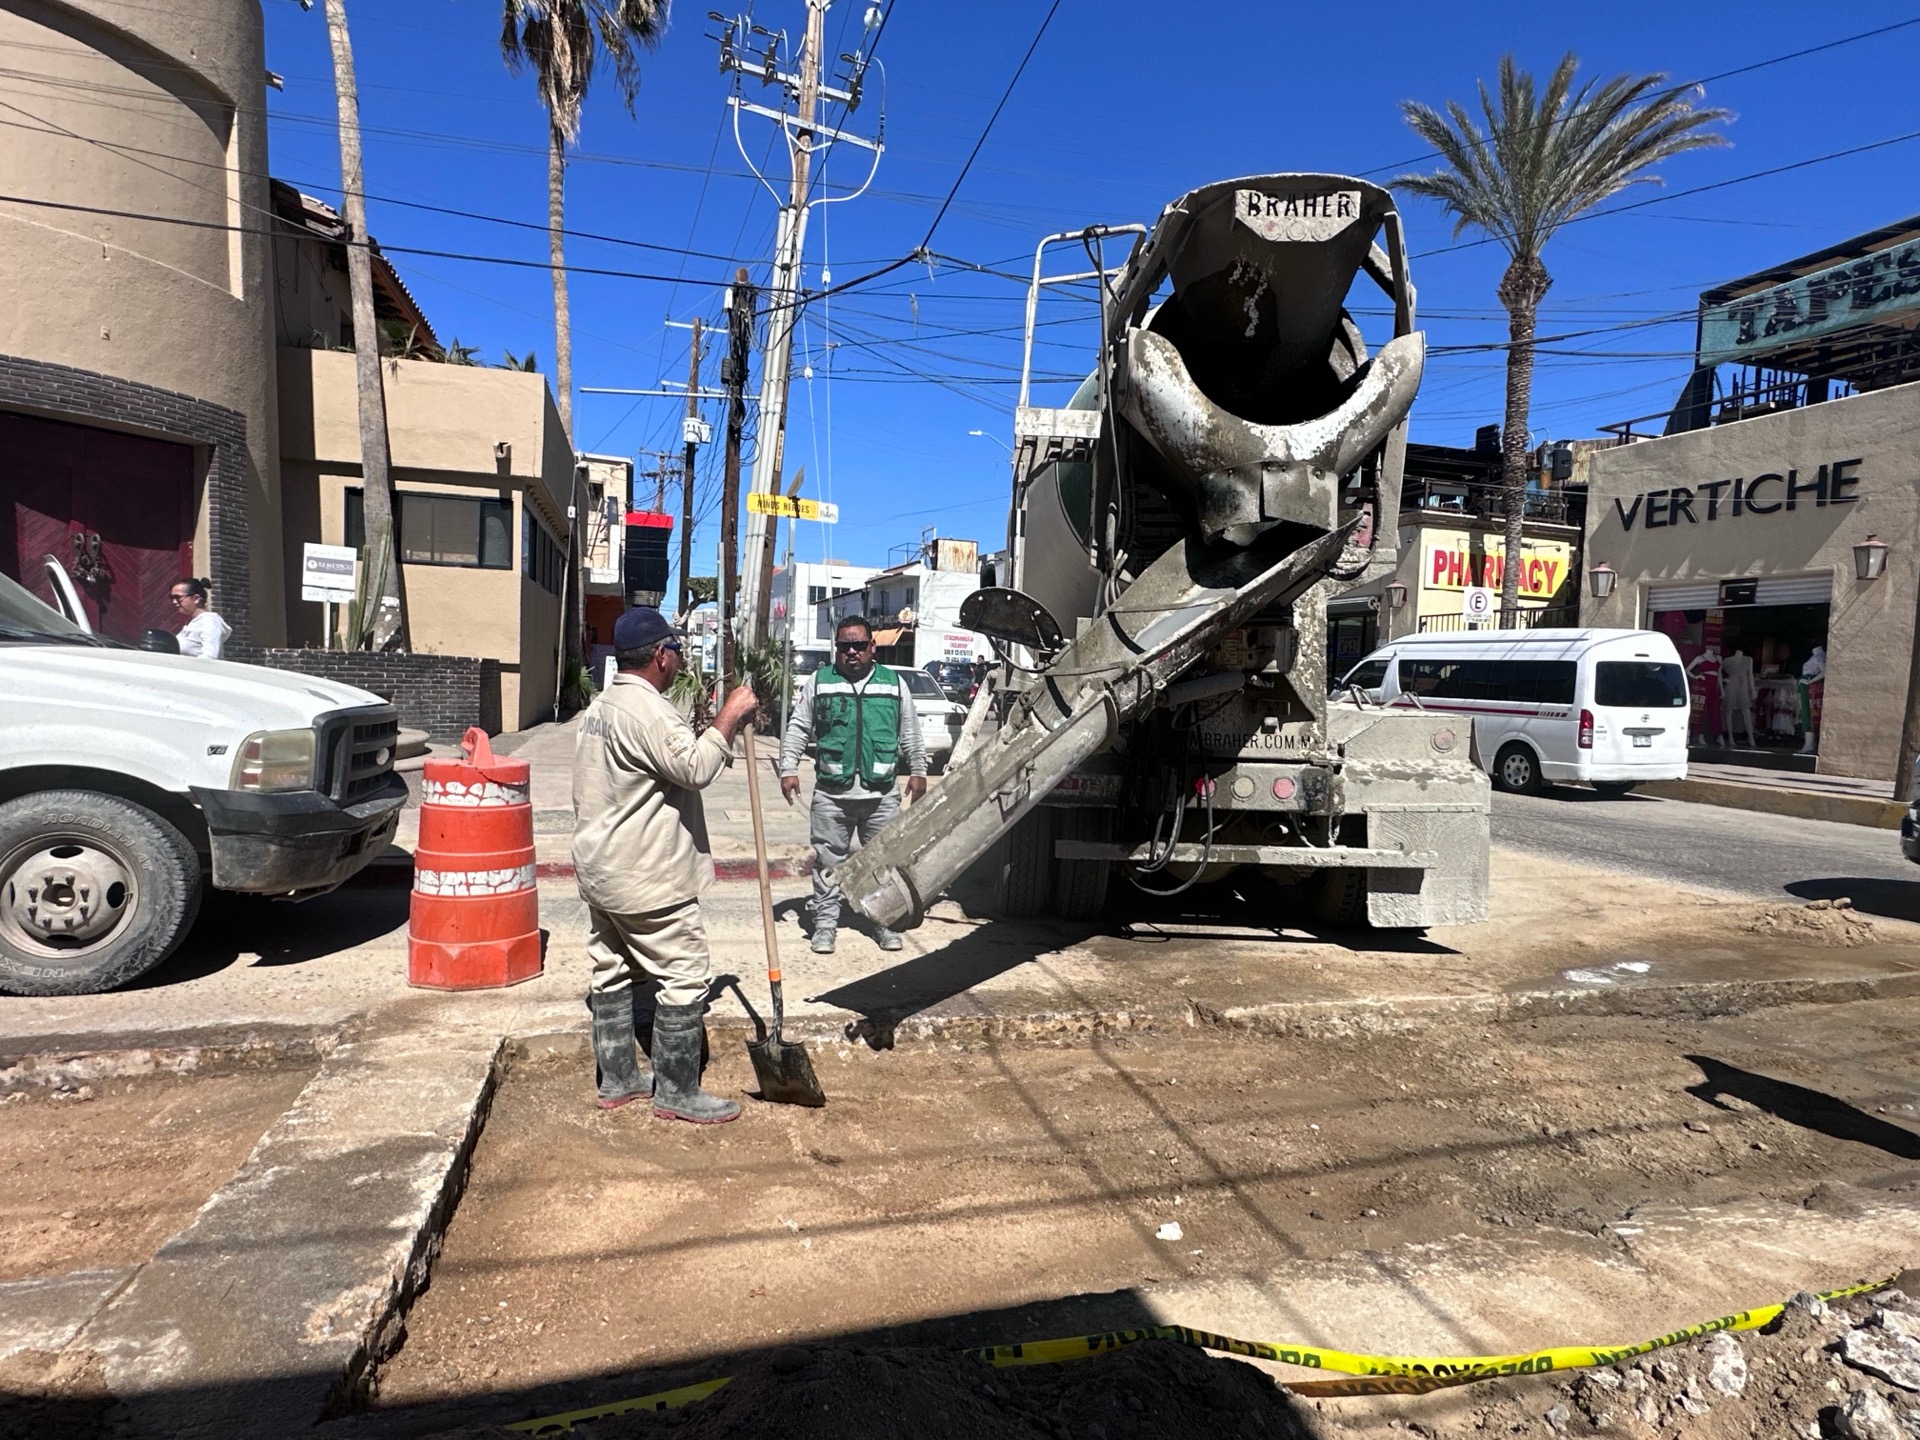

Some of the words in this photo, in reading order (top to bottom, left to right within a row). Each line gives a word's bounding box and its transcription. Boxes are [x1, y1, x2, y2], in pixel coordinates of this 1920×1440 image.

[1248, 192, 1351, 218] BRAHER
[1614, 458, 1863, 531] VERTICHE
[1474, 595, 1482, 610] E
